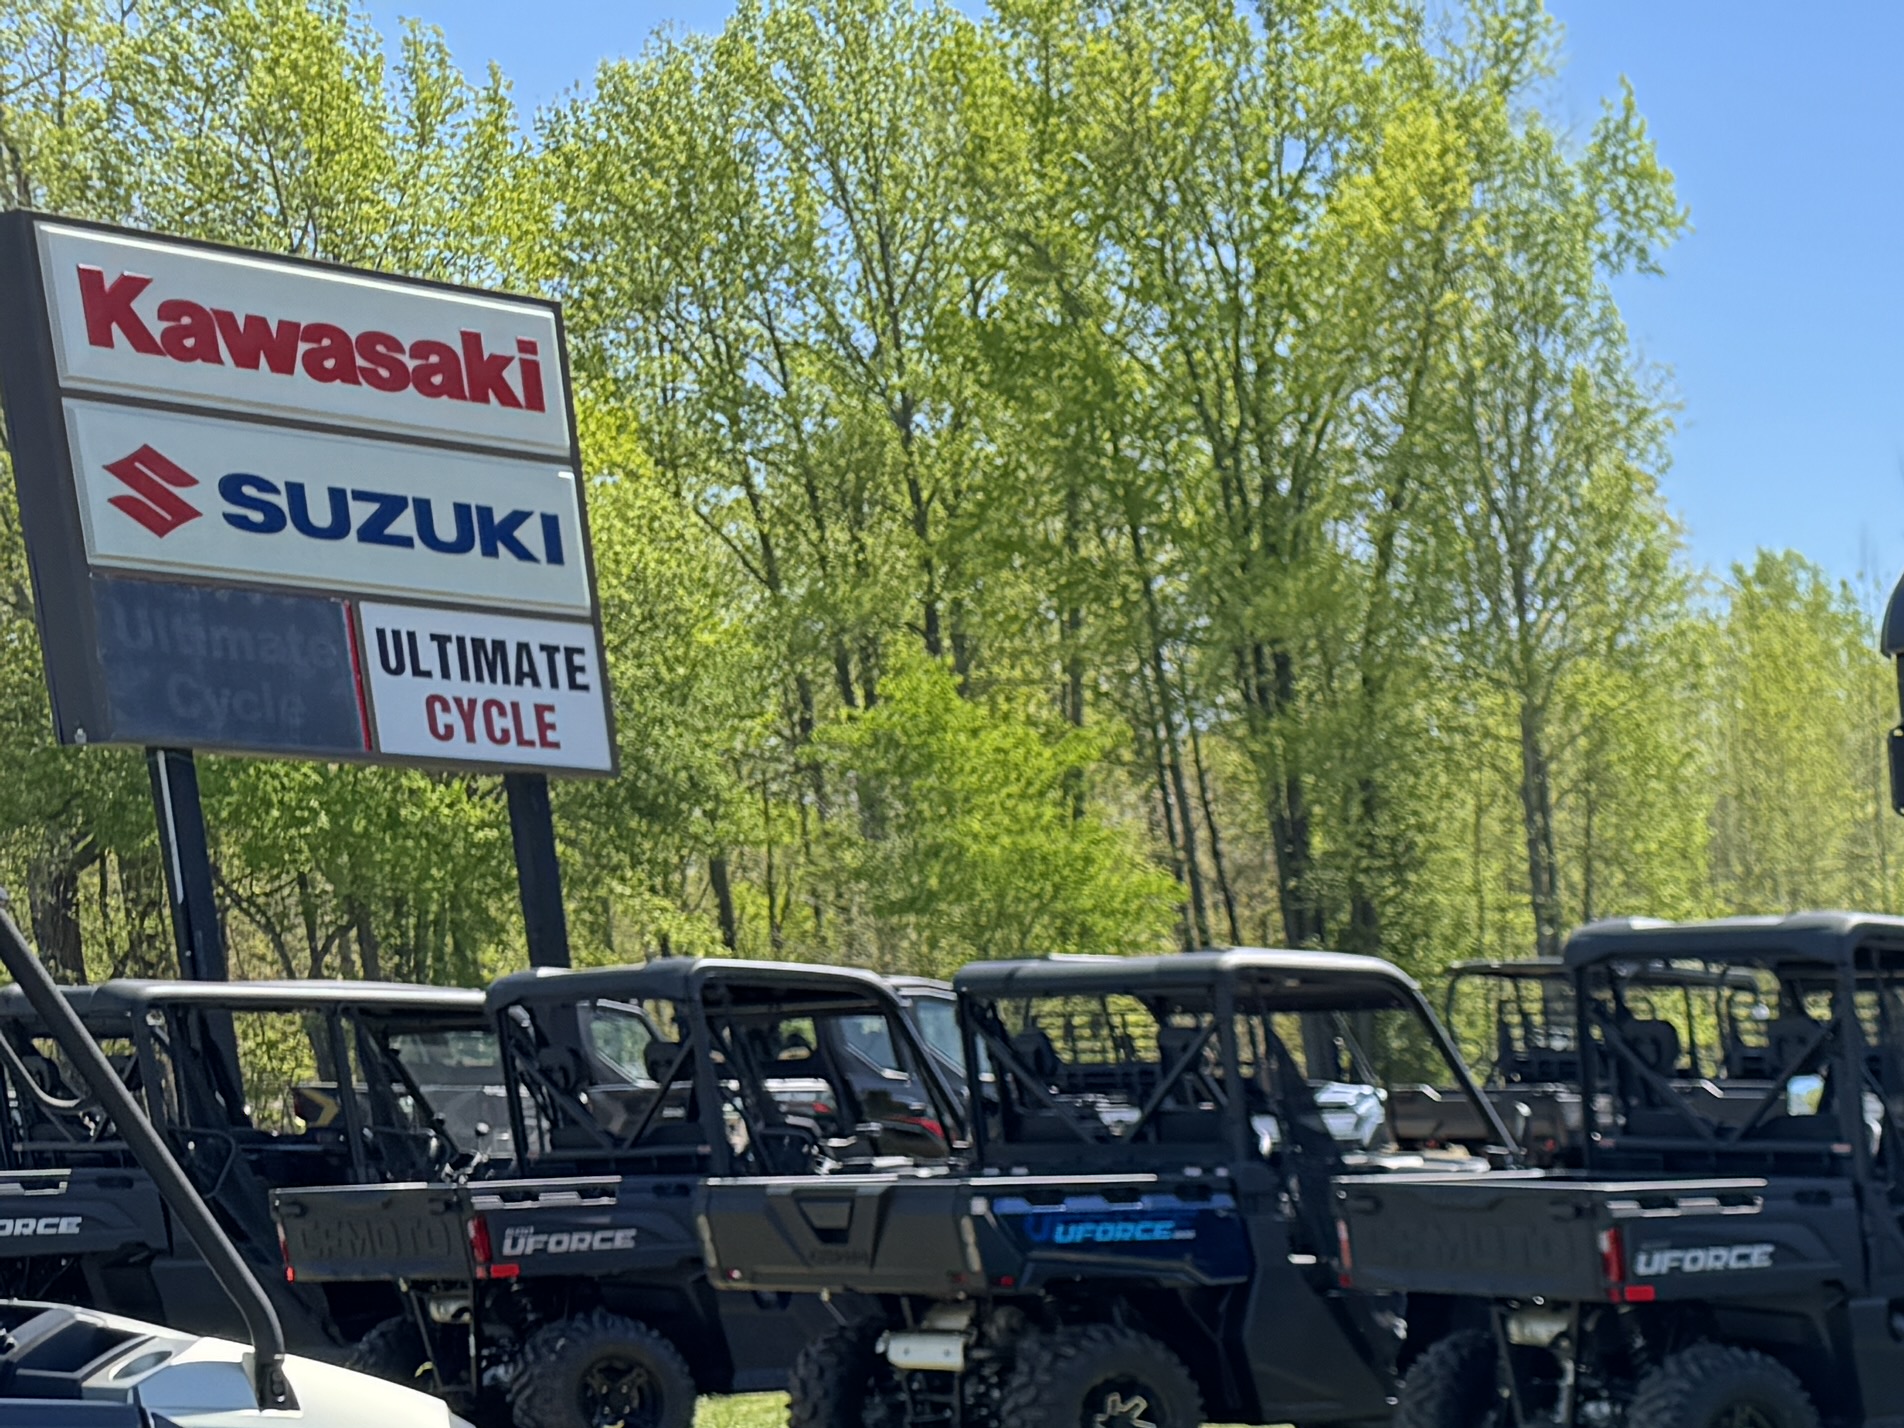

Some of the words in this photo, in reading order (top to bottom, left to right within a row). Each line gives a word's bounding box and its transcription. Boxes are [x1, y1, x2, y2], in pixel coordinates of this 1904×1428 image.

[76, 262, 546, 413] Kawasaki
[217, 471, 565, 566] SUZUKI
[375, 626, 591, 693] ULTIMATE
[424, 693, 562, 750] CYCLE
[502, 1228, 637, 1256] UFORCE
[1635, 1243, 1775, 1277] UFORCE
